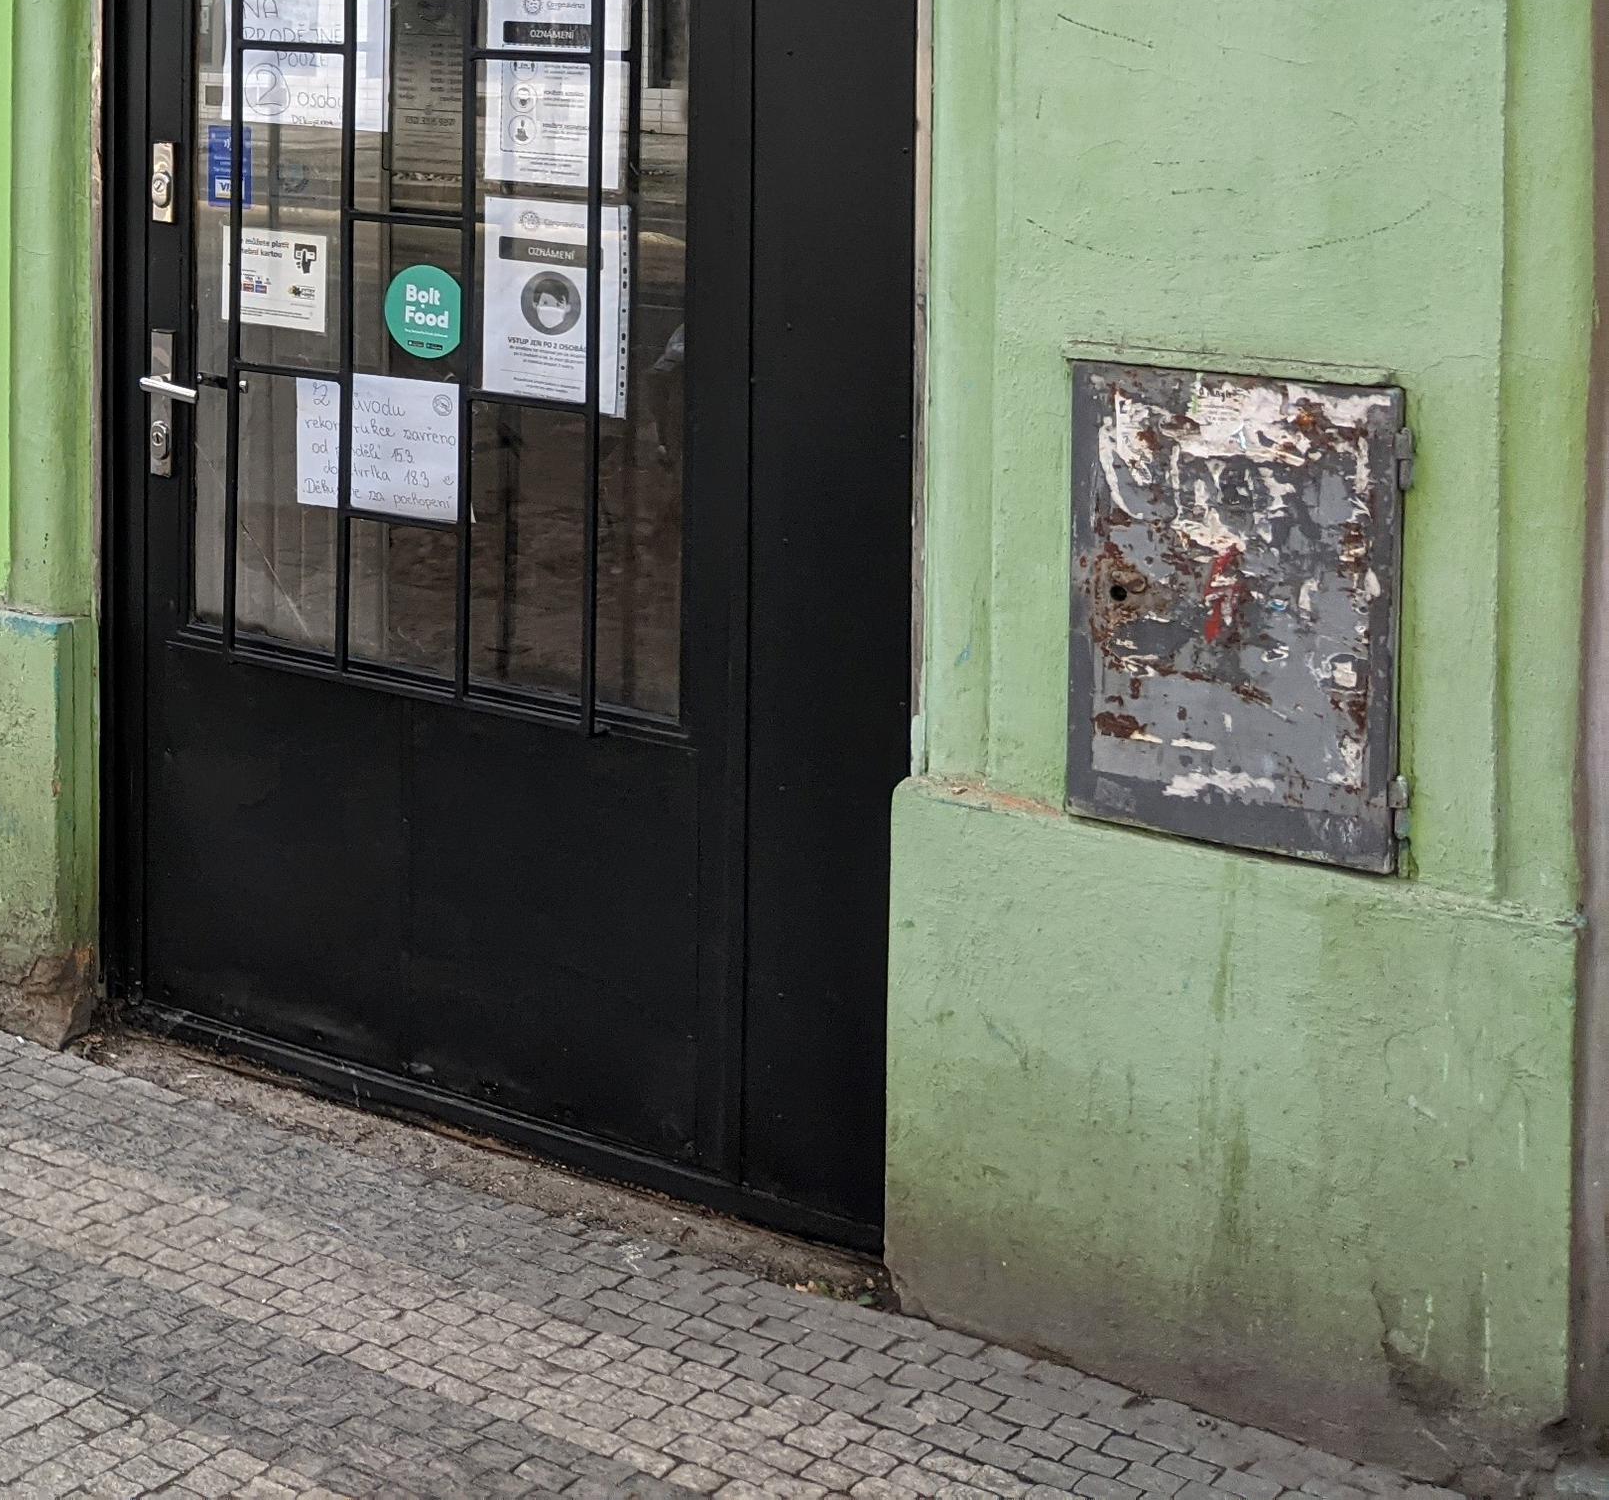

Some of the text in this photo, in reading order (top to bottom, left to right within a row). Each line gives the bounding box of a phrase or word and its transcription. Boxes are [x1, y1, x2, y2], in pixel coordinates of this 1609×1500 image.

[529, 28, 575, 40] OZNÁMENÍ
[277, 51, 328, 68] POUZE
[528, 246, 575, 261] OZNÁMENÍ
[405, 283, 441, 306] Bolt
[405, 305, 449, 329] Food
[507, 336, 529, 345] VSTUP
[352, 392, 406, 417] ůvodu
[311, 439, 328, 454] od
